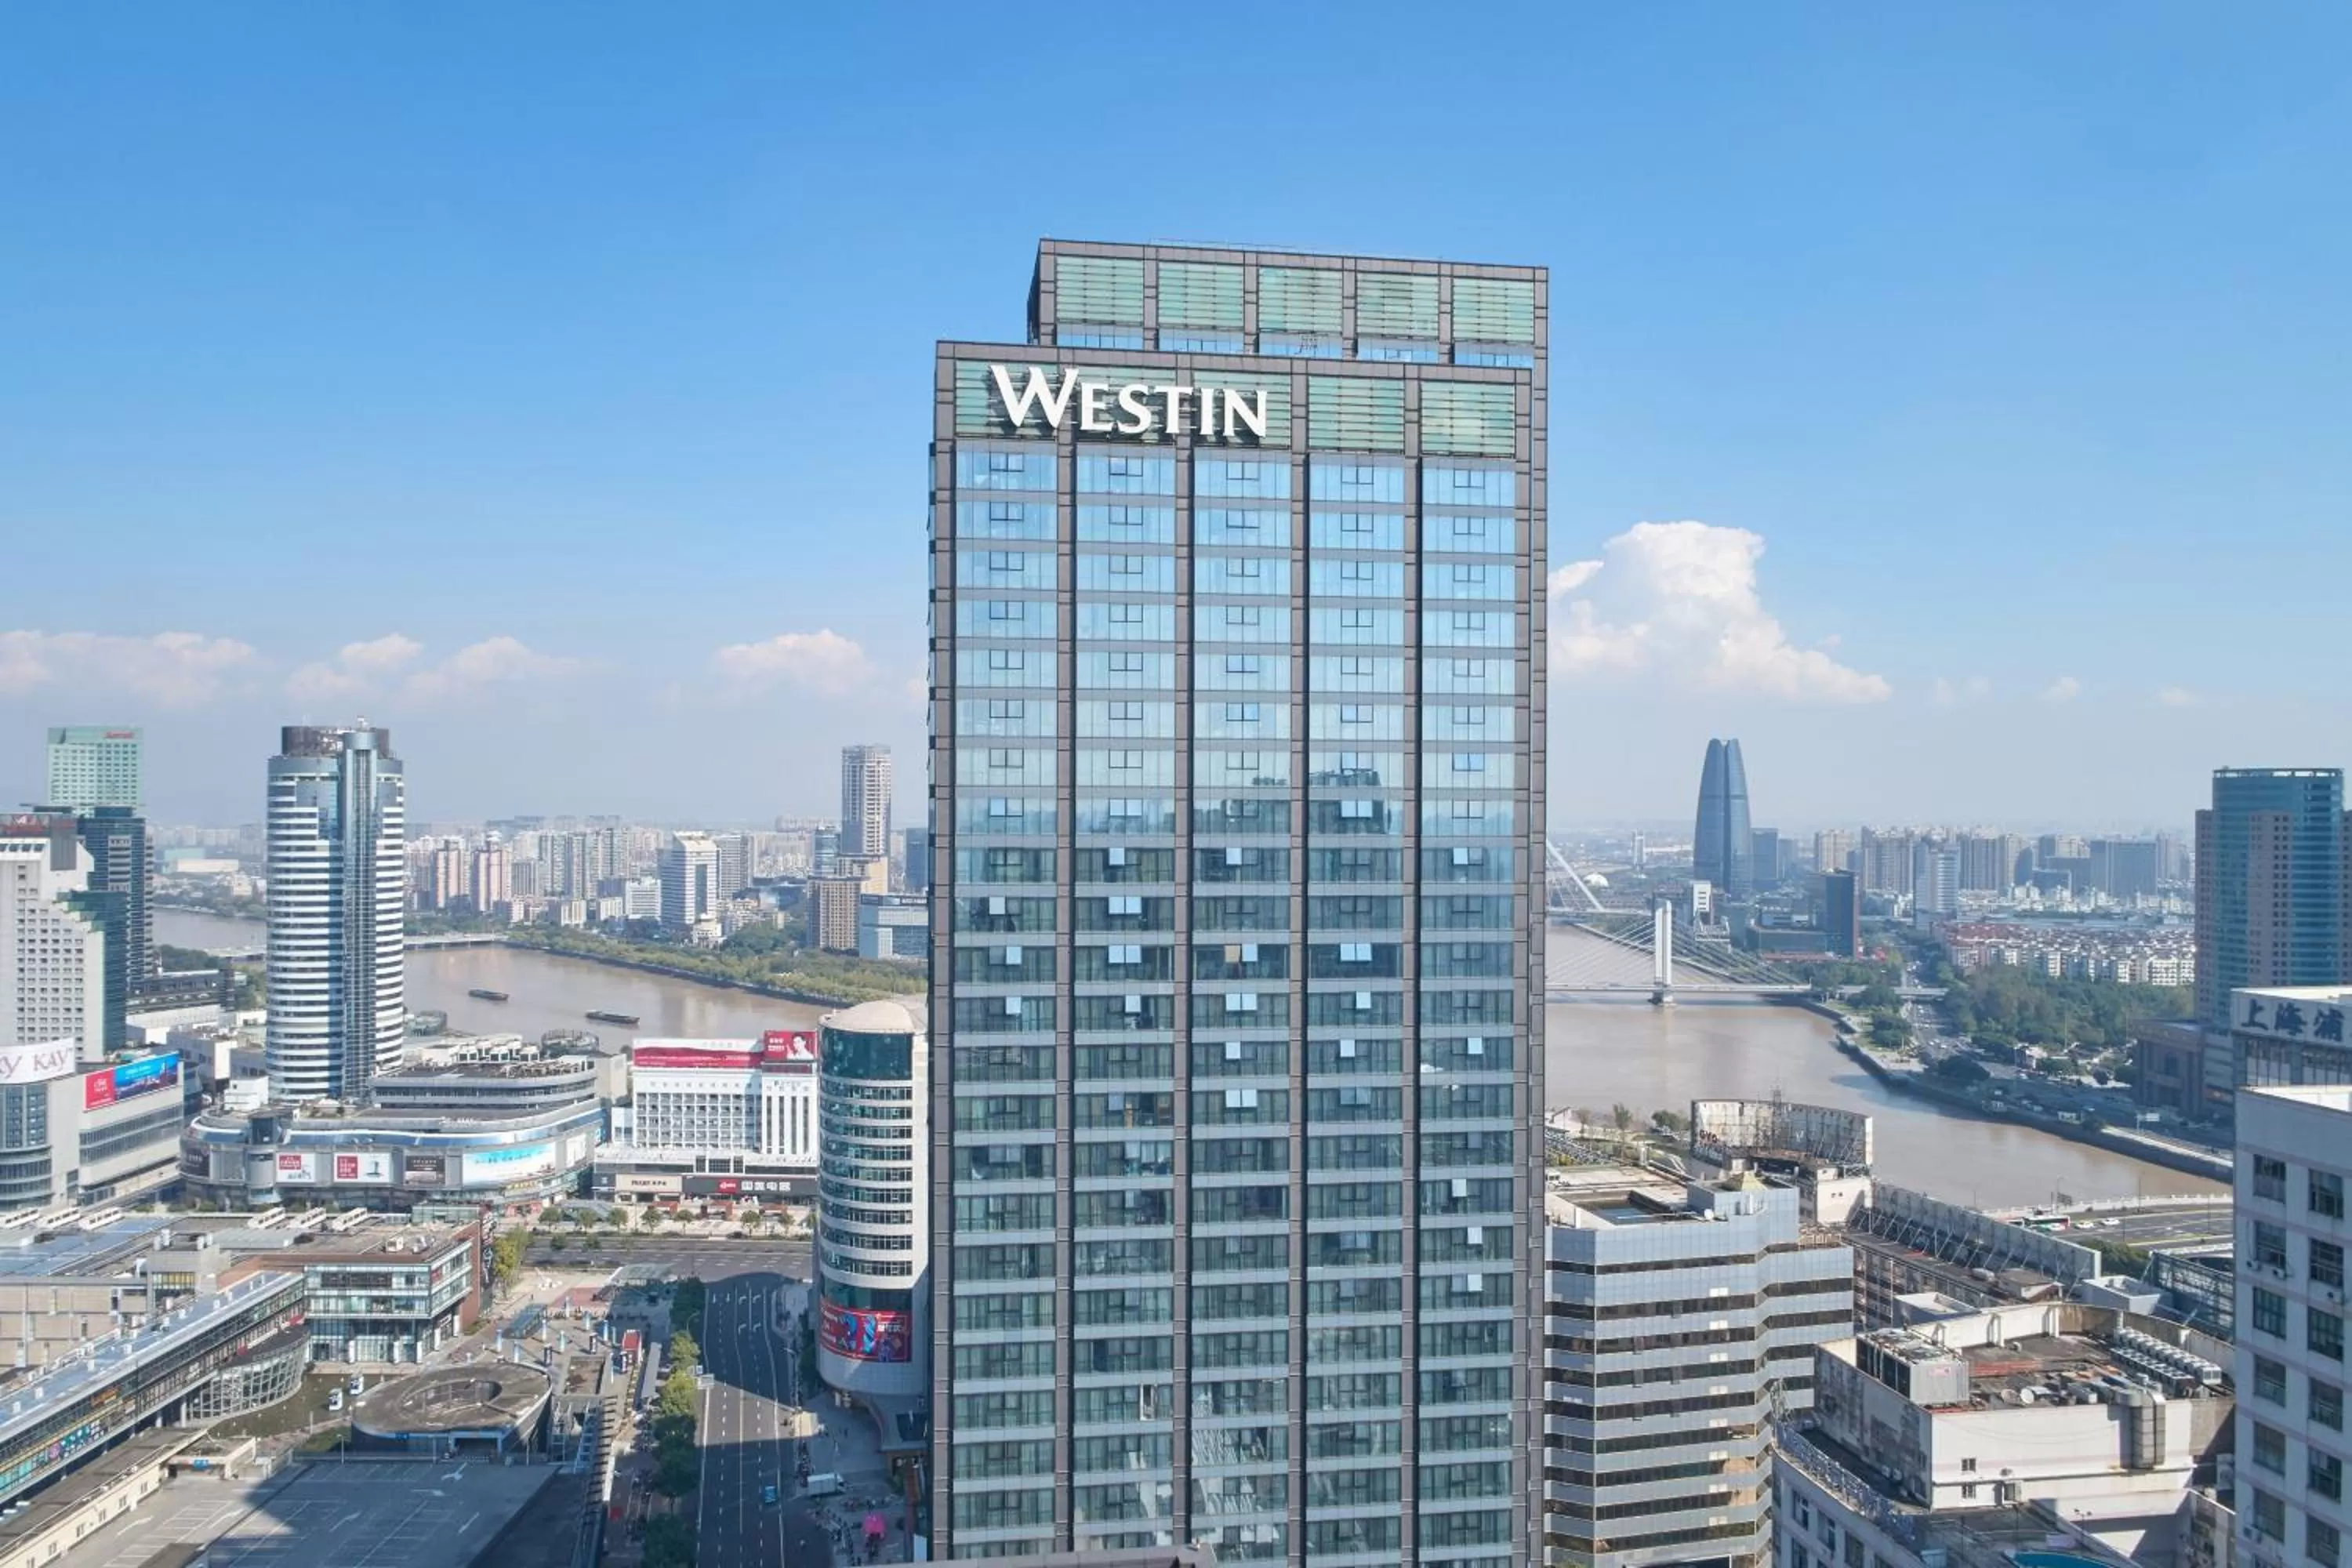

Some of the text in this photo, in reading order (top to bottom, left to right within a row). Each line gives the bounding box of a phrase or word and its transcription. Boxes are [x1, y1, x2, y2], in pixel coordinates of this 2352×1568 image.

[990, 365, 1268, 437] WESTIN
[2241, 999, 2352, 1042] 上海浦
[32, 1050, 68, 1072] KAY
